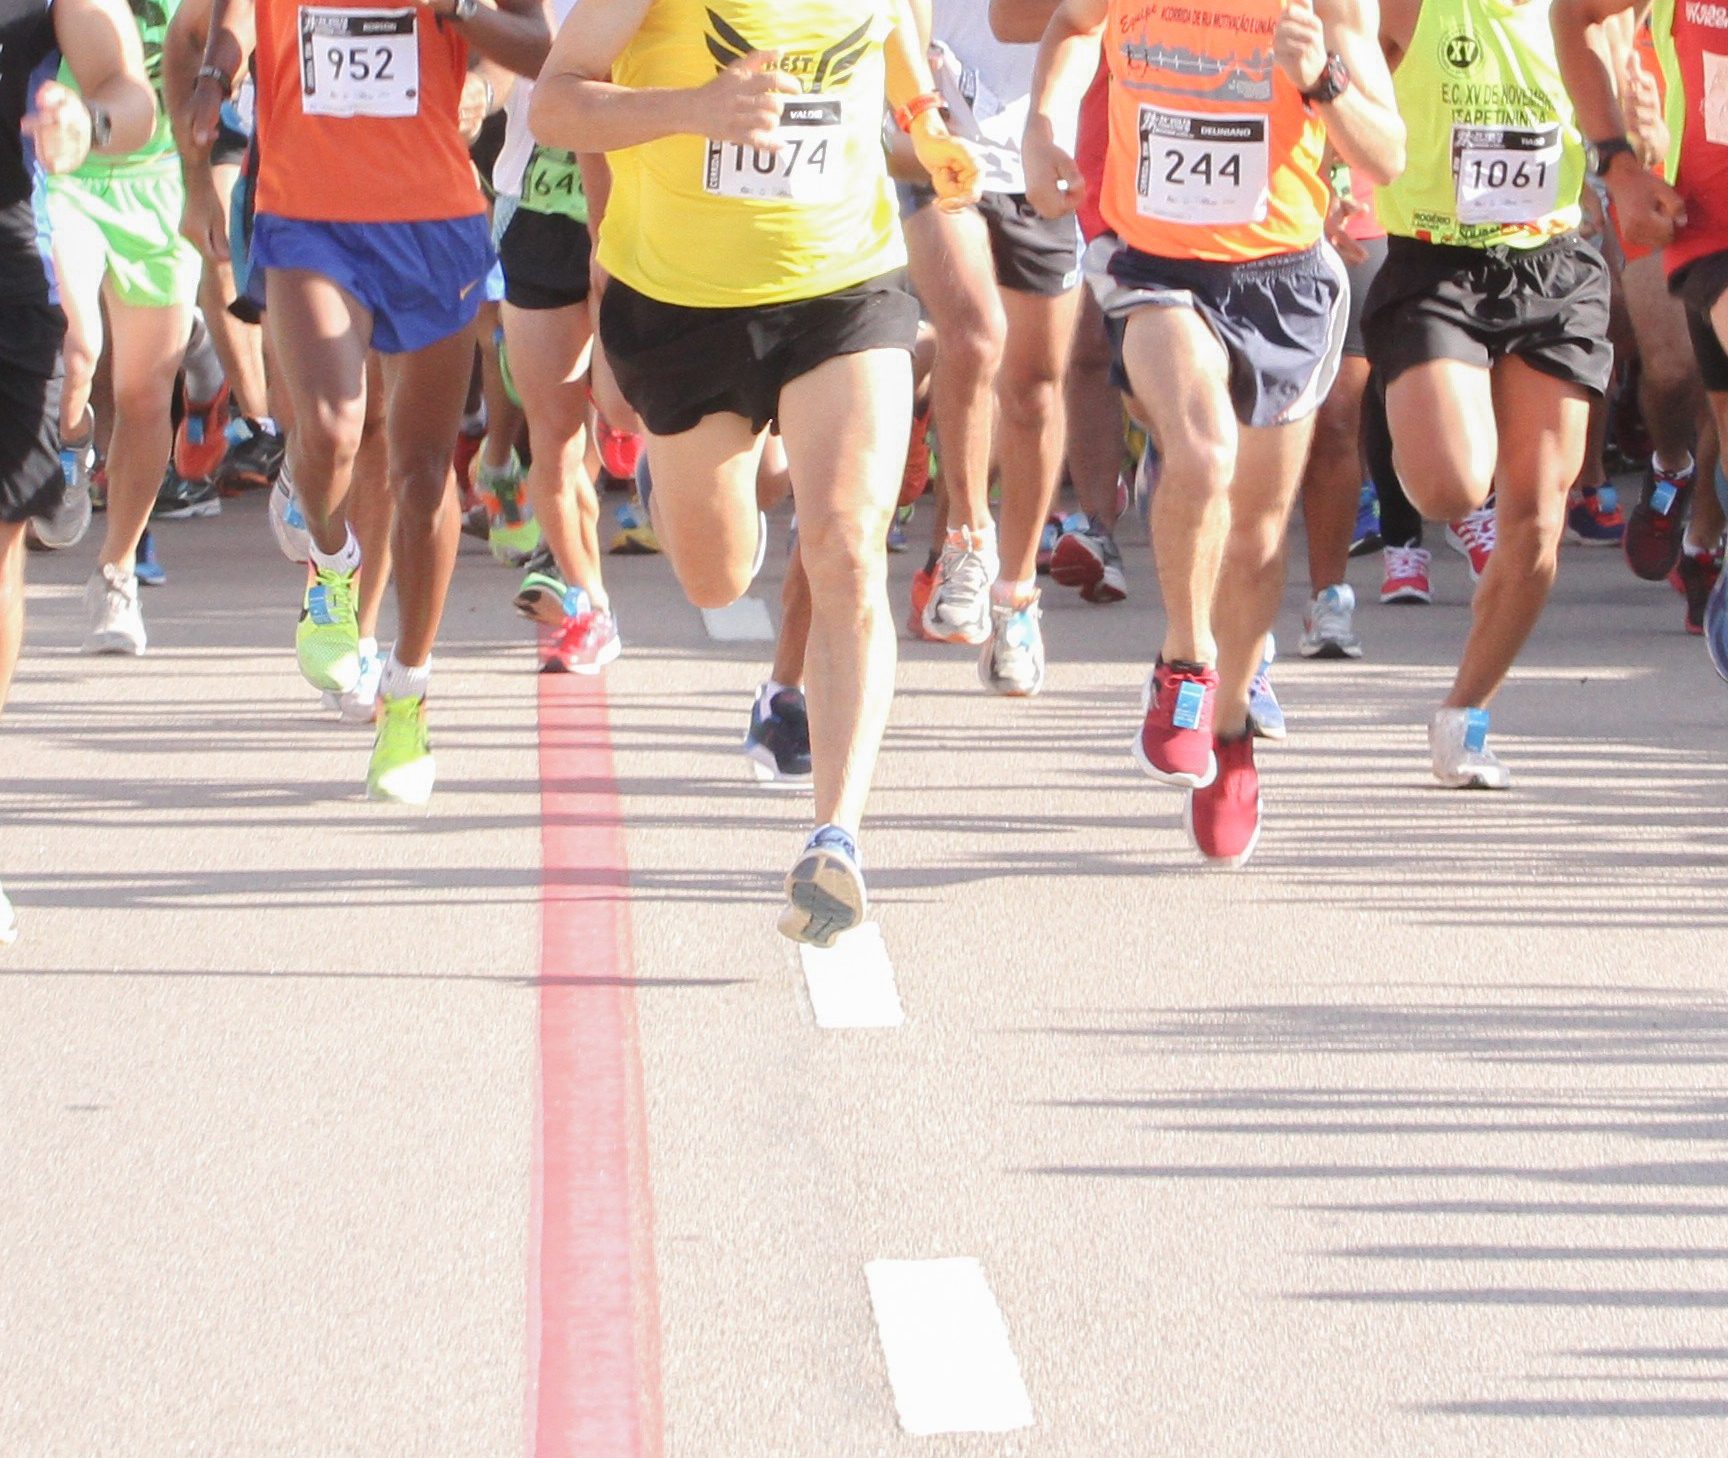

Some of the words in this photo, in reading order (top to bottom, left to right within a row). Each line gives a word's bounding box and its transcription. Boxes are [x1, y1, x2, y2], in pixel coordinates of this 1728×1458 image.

[327, 46, 395, 81] 952
[1450, 41, 1476, 62] XV
[731, 139, 828, 177] 1074
[1165, 149, 1240, 186] 244
[1472, 159, 1546, 190] 1061
[534, 167, 584, 197] 64
